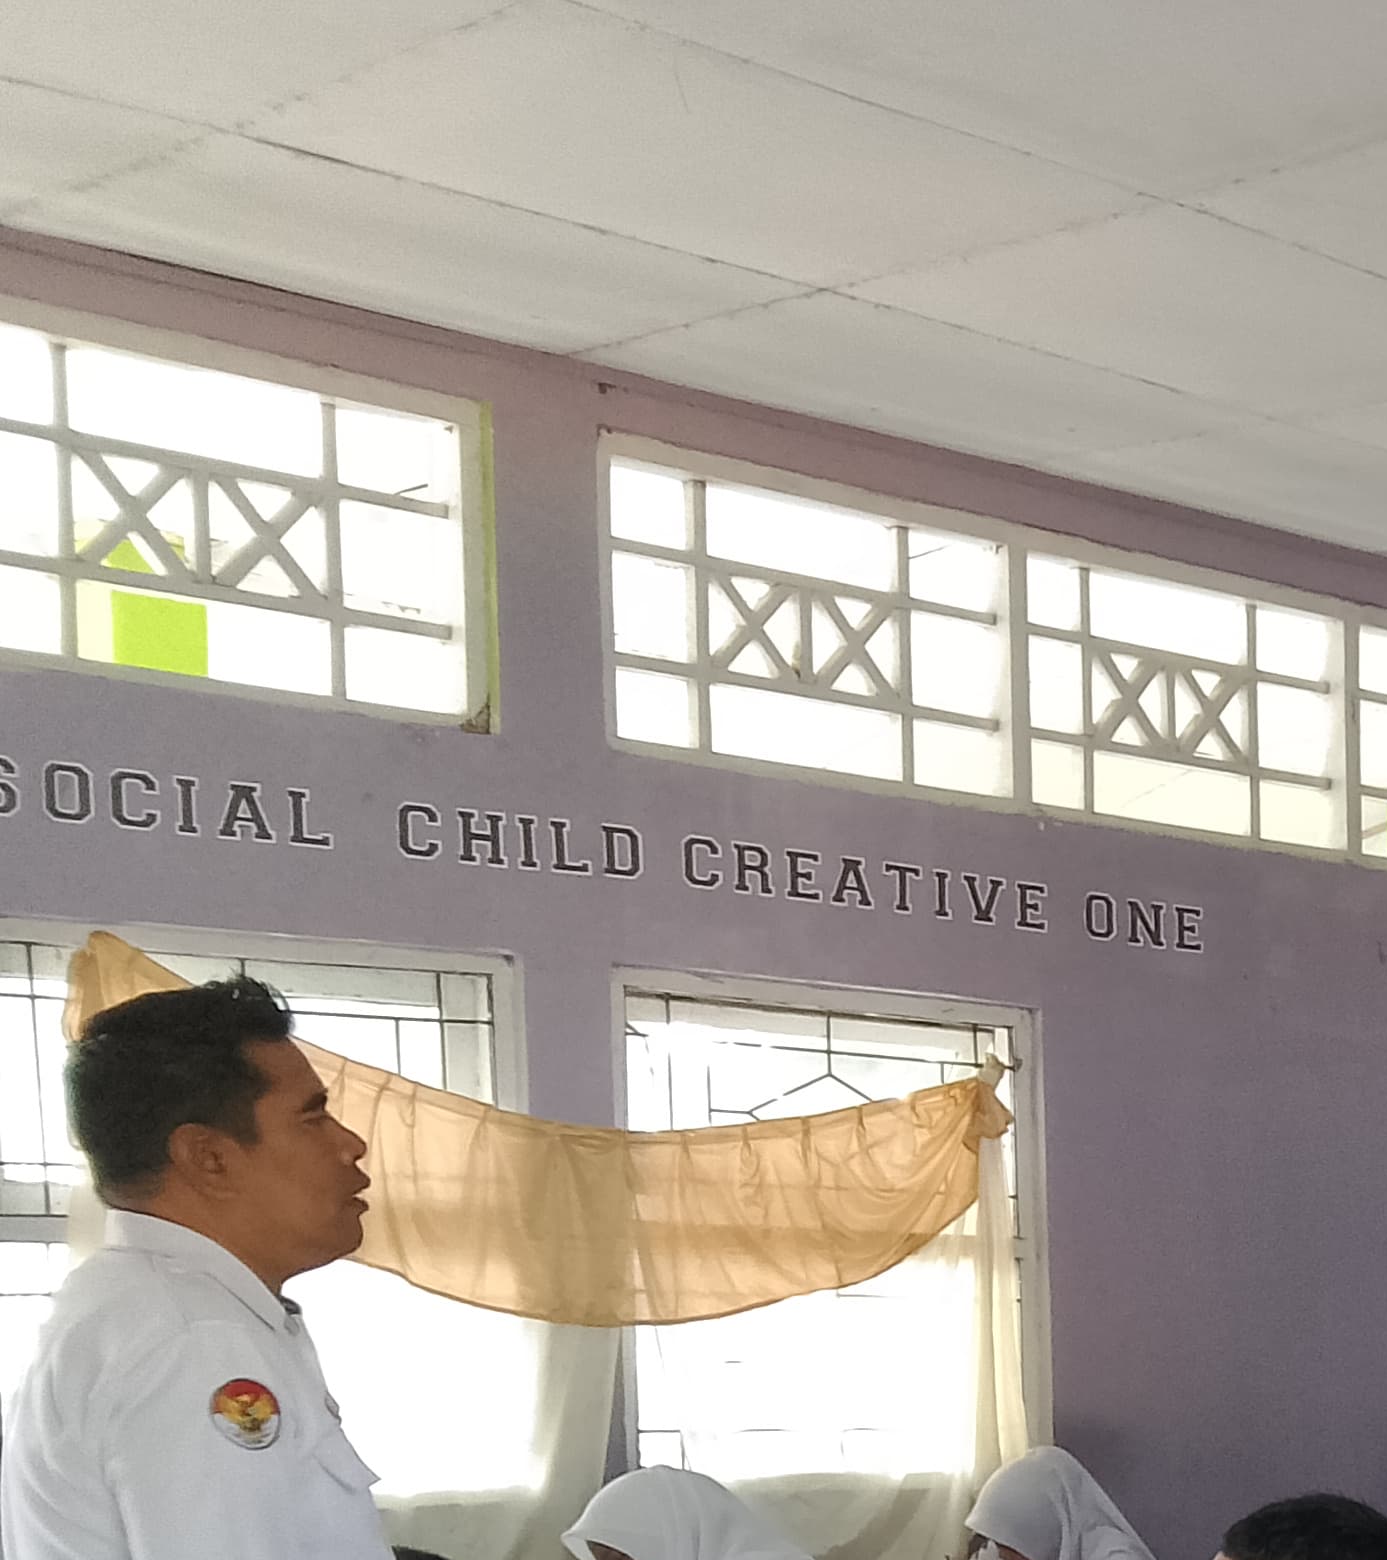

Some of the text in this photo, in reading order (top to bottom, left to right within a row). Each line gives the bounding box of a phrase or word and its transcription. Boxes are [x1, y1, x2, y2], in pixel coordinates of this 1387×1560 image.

[398, 803, 643, 880] CHILD
[682, 834, 1047, 932] CREATIVE
[1084, 892, 1203, 952] ONE
